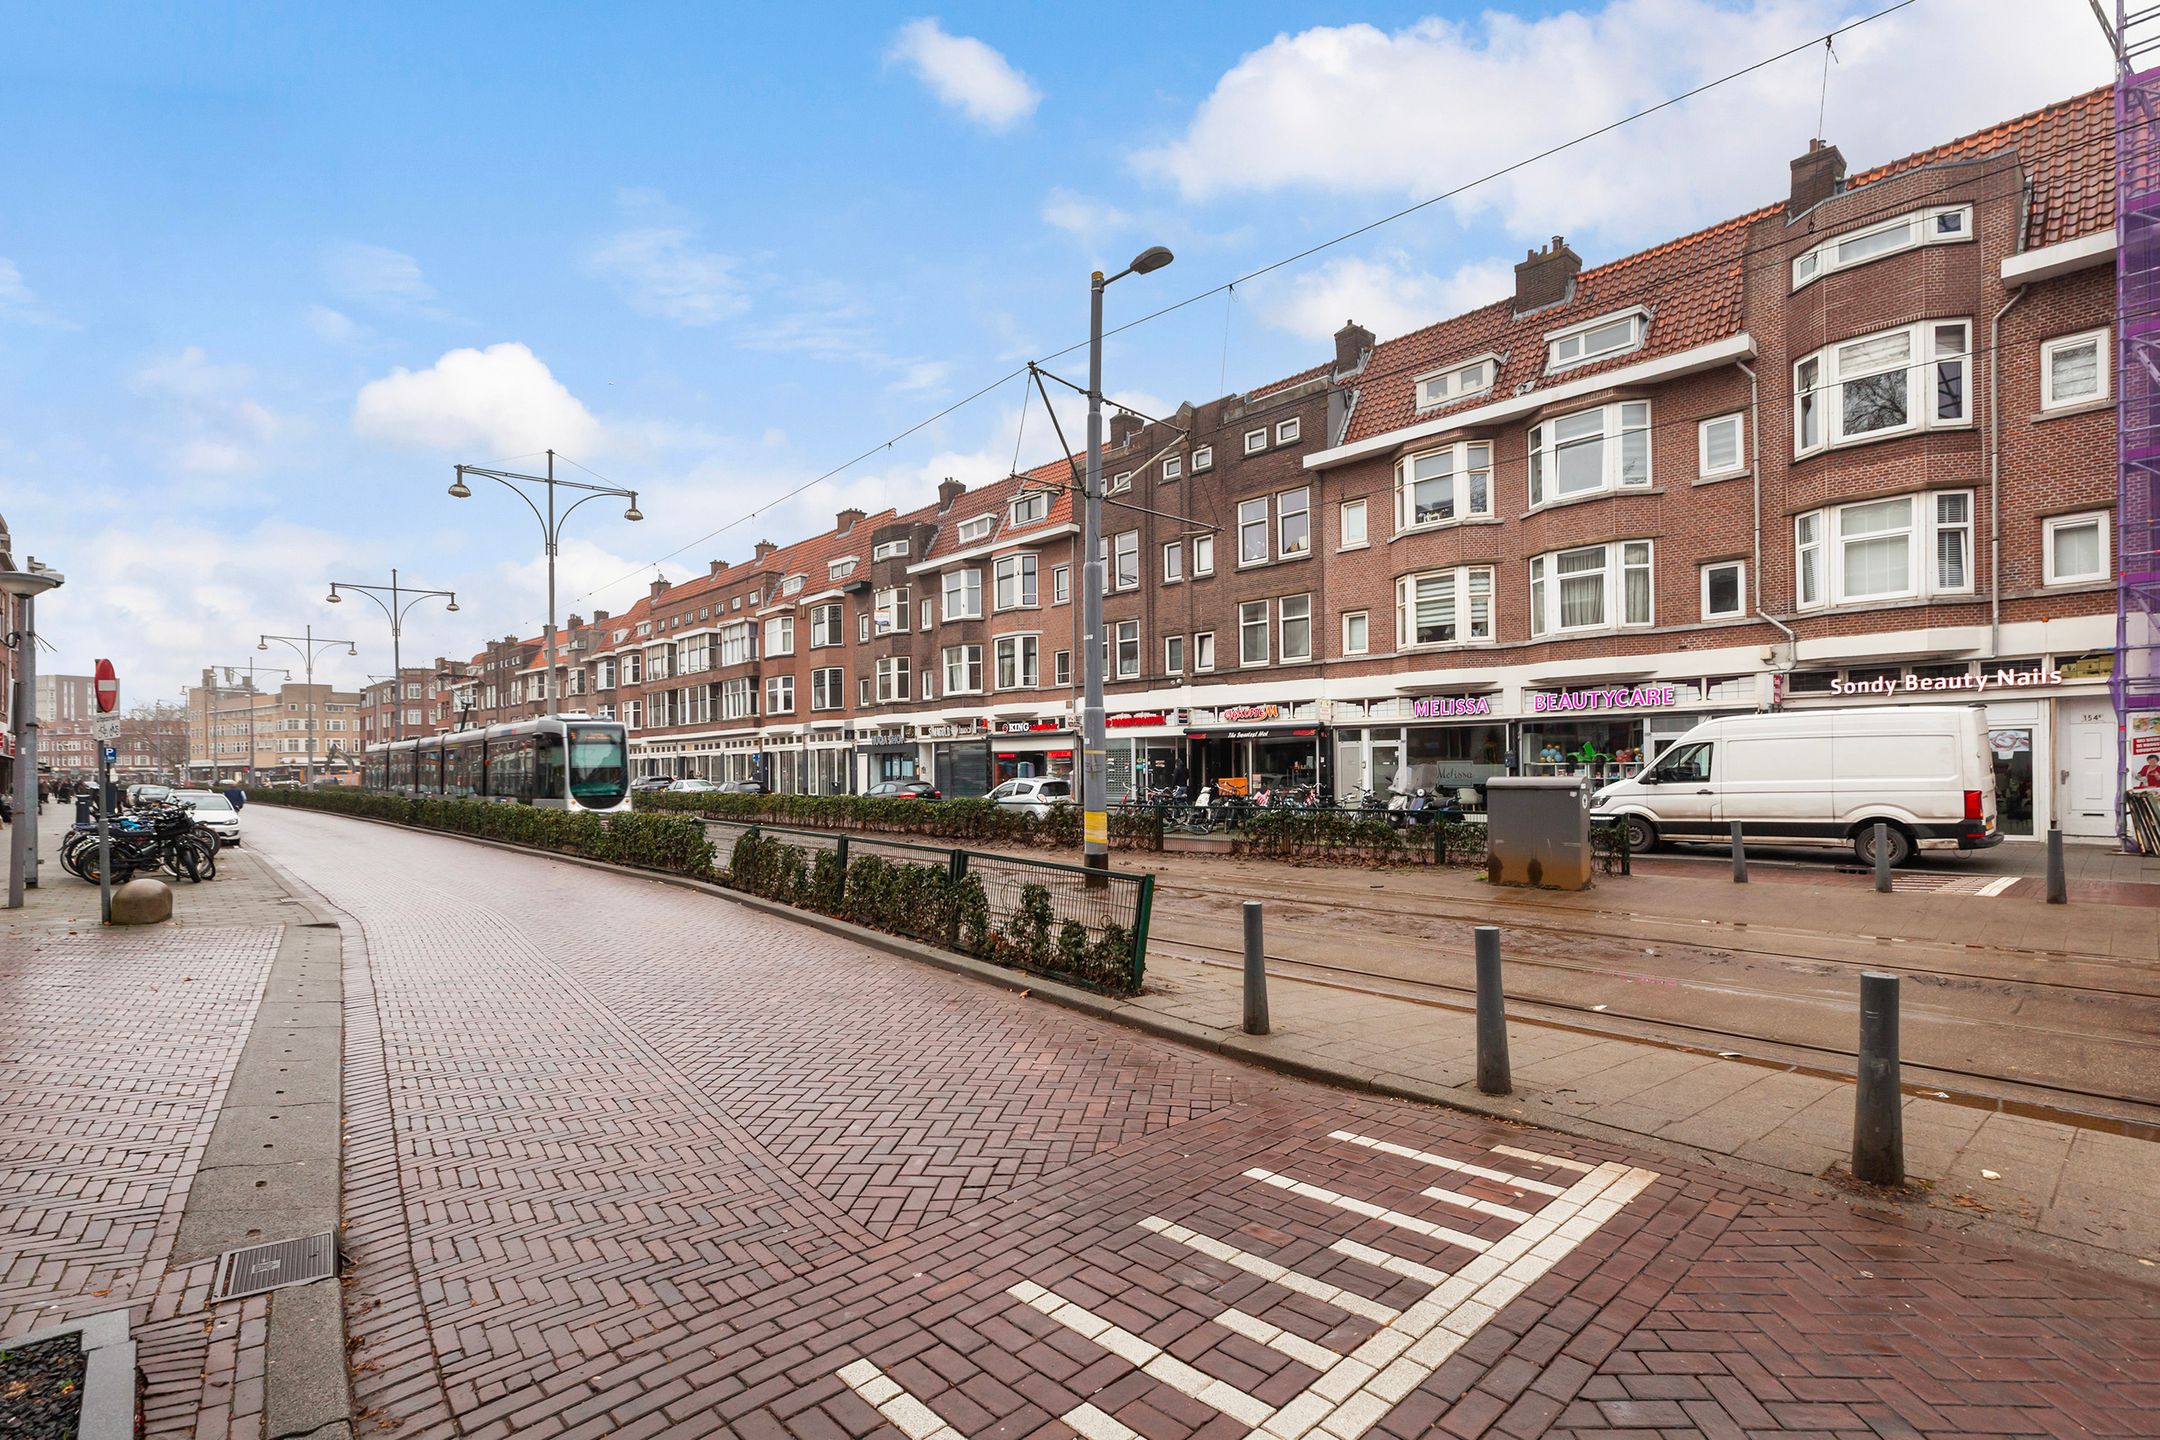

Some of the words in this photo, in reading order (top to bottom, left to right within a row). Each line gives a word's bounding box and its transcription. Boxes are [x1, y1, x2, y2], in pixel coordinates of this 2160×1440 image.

[1830, 676, 1897, 696] Sondy
[1904, 673, 1989, 692] Beauty
[1997, 668, 2063, 686] Nails
[1534, 687, 1676, 711] BEAUTYCARE
[1414, 697, 1490, 717] MELISSA
[1009, 722, 1029, 732] KING
[105, 748, 115, 756] P
[1437, 768, 1473, 778] Melissa
